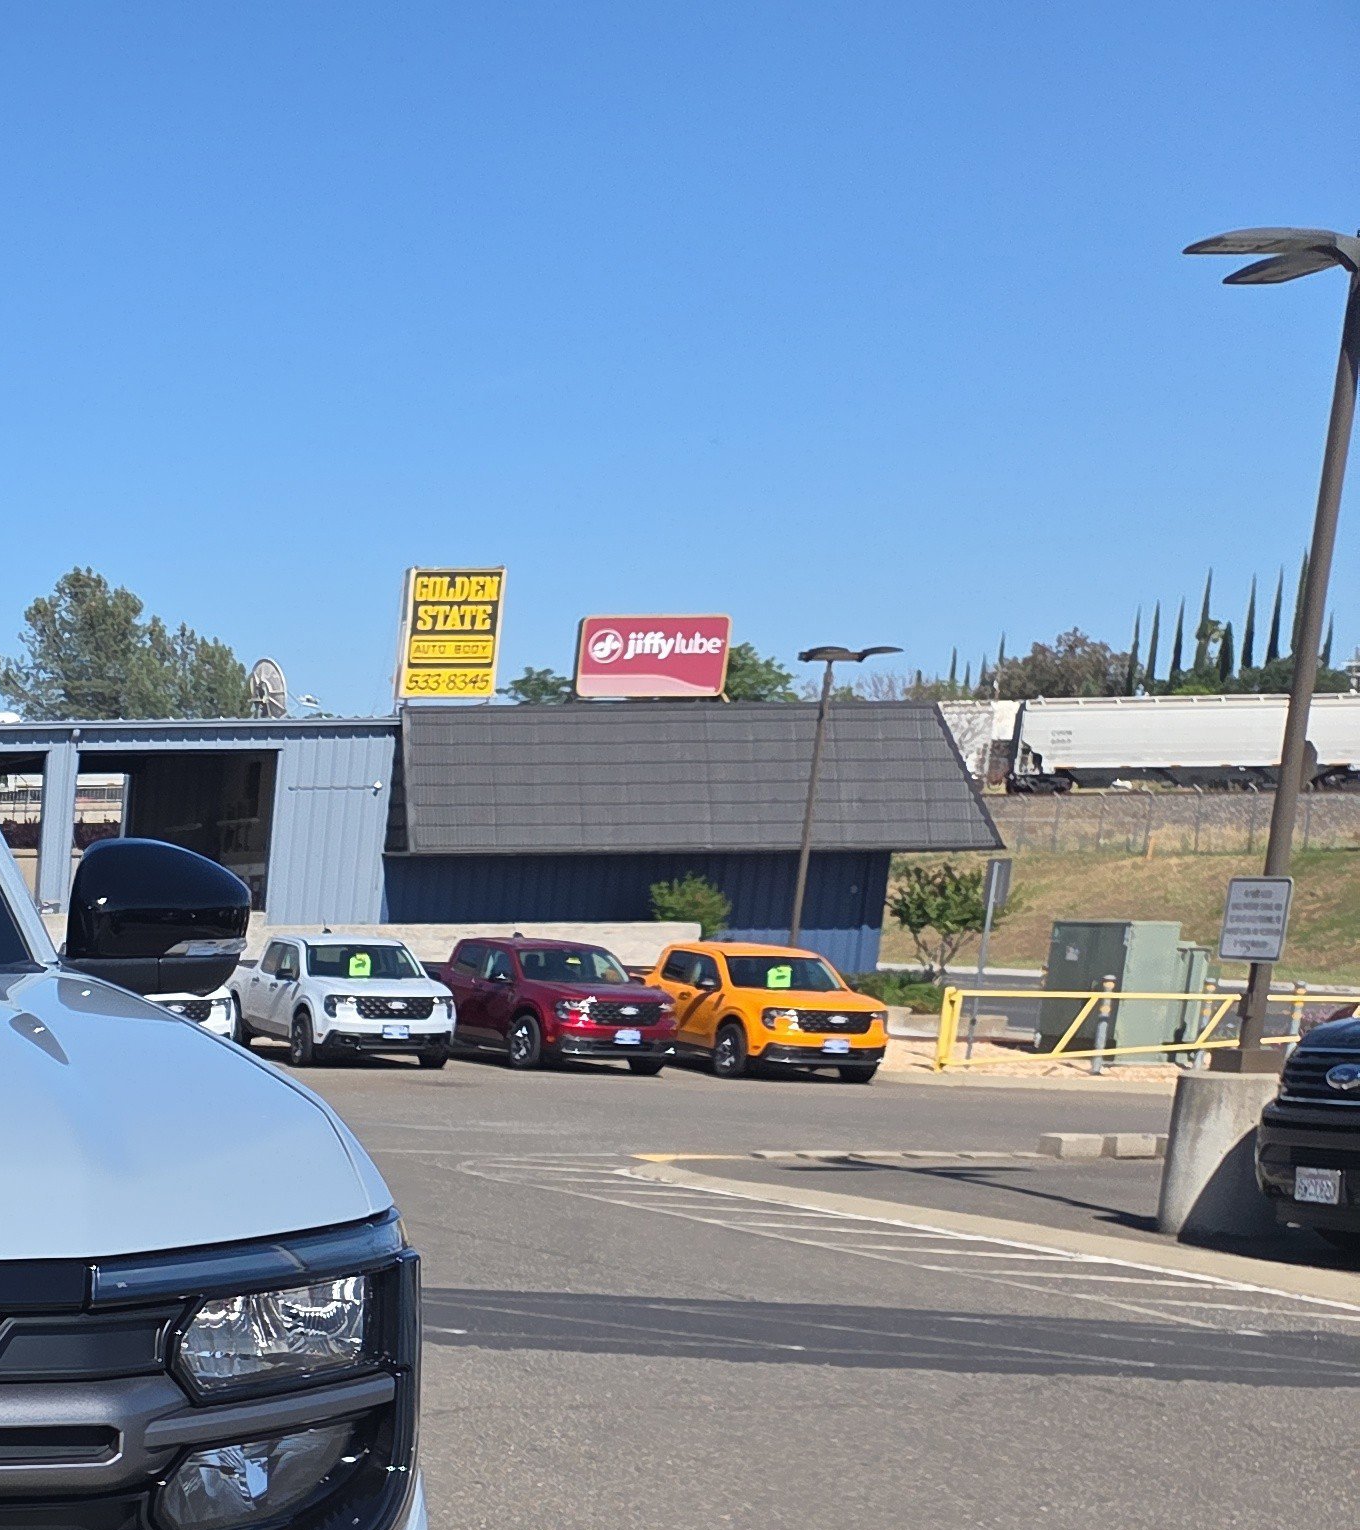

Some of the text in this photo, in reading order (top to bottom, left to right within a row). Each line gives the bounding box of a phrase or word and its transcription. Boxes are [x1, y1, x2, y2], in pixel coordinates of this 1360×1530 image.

[415, 576, 500, 601] GOLDEN
[416, 605, 492, 630] STATE
[413, 644, 488, 655] AUTO BODY
[406, 673, 490, 691] 533-8345
